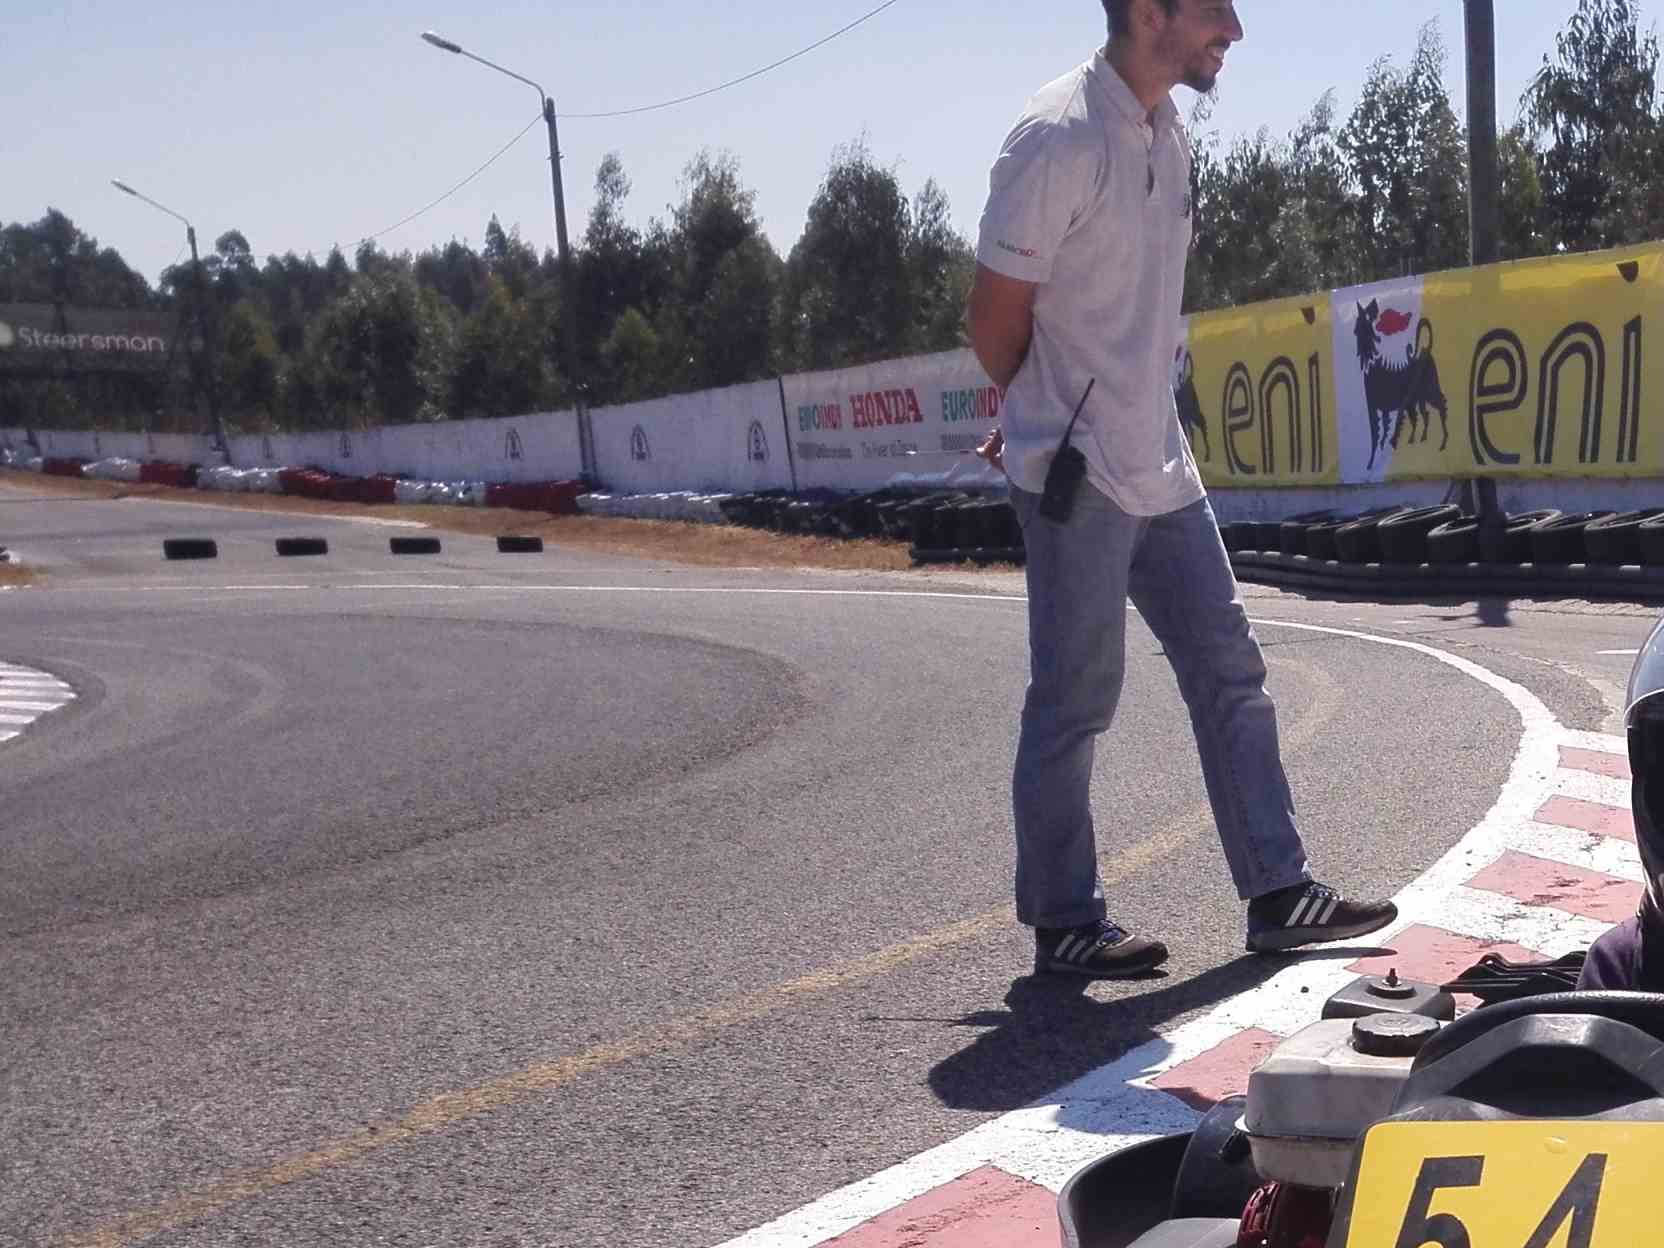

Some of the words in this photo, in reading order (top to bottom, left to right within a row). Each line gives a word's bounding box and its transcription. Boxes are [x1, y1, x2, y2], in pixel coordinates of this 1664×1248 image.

[849, 387, 924, 428] HONDA
[1222, 306, 1323, 475] eni
[1469, 261, 1642, 465] eni
